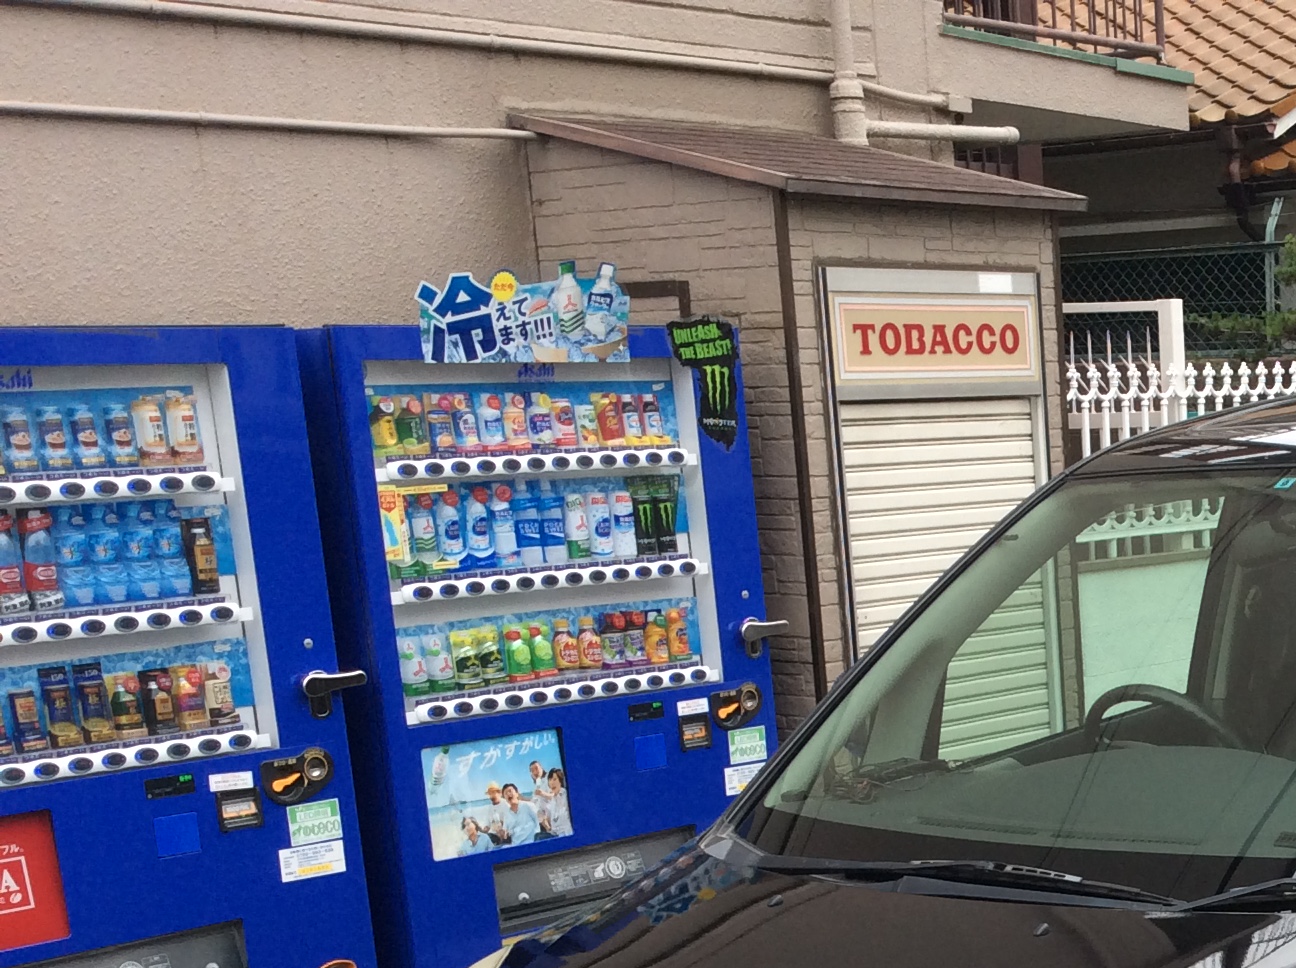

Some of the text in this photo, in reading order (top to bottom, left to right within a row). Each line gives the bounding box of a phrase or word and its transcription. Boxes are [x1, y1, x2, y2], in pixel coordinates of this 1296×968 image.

[493, 282, 515, 293] ただ今
[415, 273, 498, 362] 冷
[673, 323, 722, 344] UNLEASH
[852, 322, 1020, 356] TOBACCO
[679, 338, 732, 360] THE BEAST!
